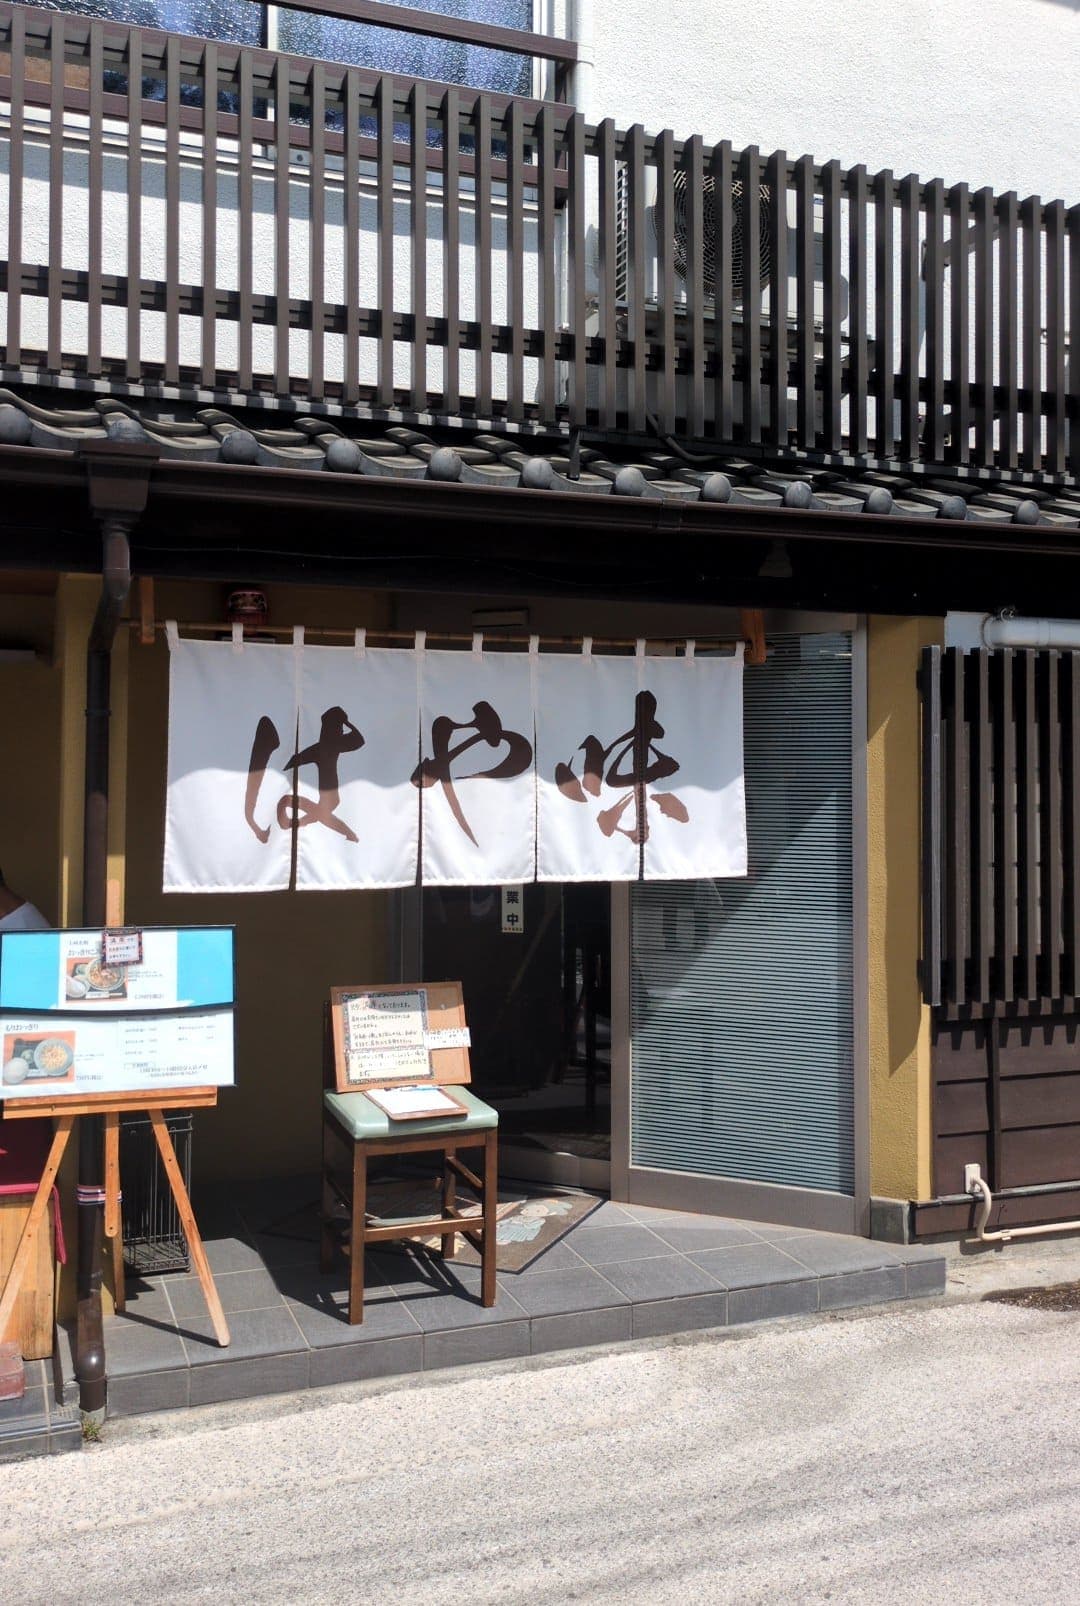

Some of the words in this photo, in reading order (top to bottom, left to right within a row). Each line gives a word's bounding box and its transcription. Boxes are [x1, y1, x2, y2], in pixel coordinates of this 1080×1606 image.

[244, 690, 689, 848] はや味
[506, 890, 520, 926] 業中
